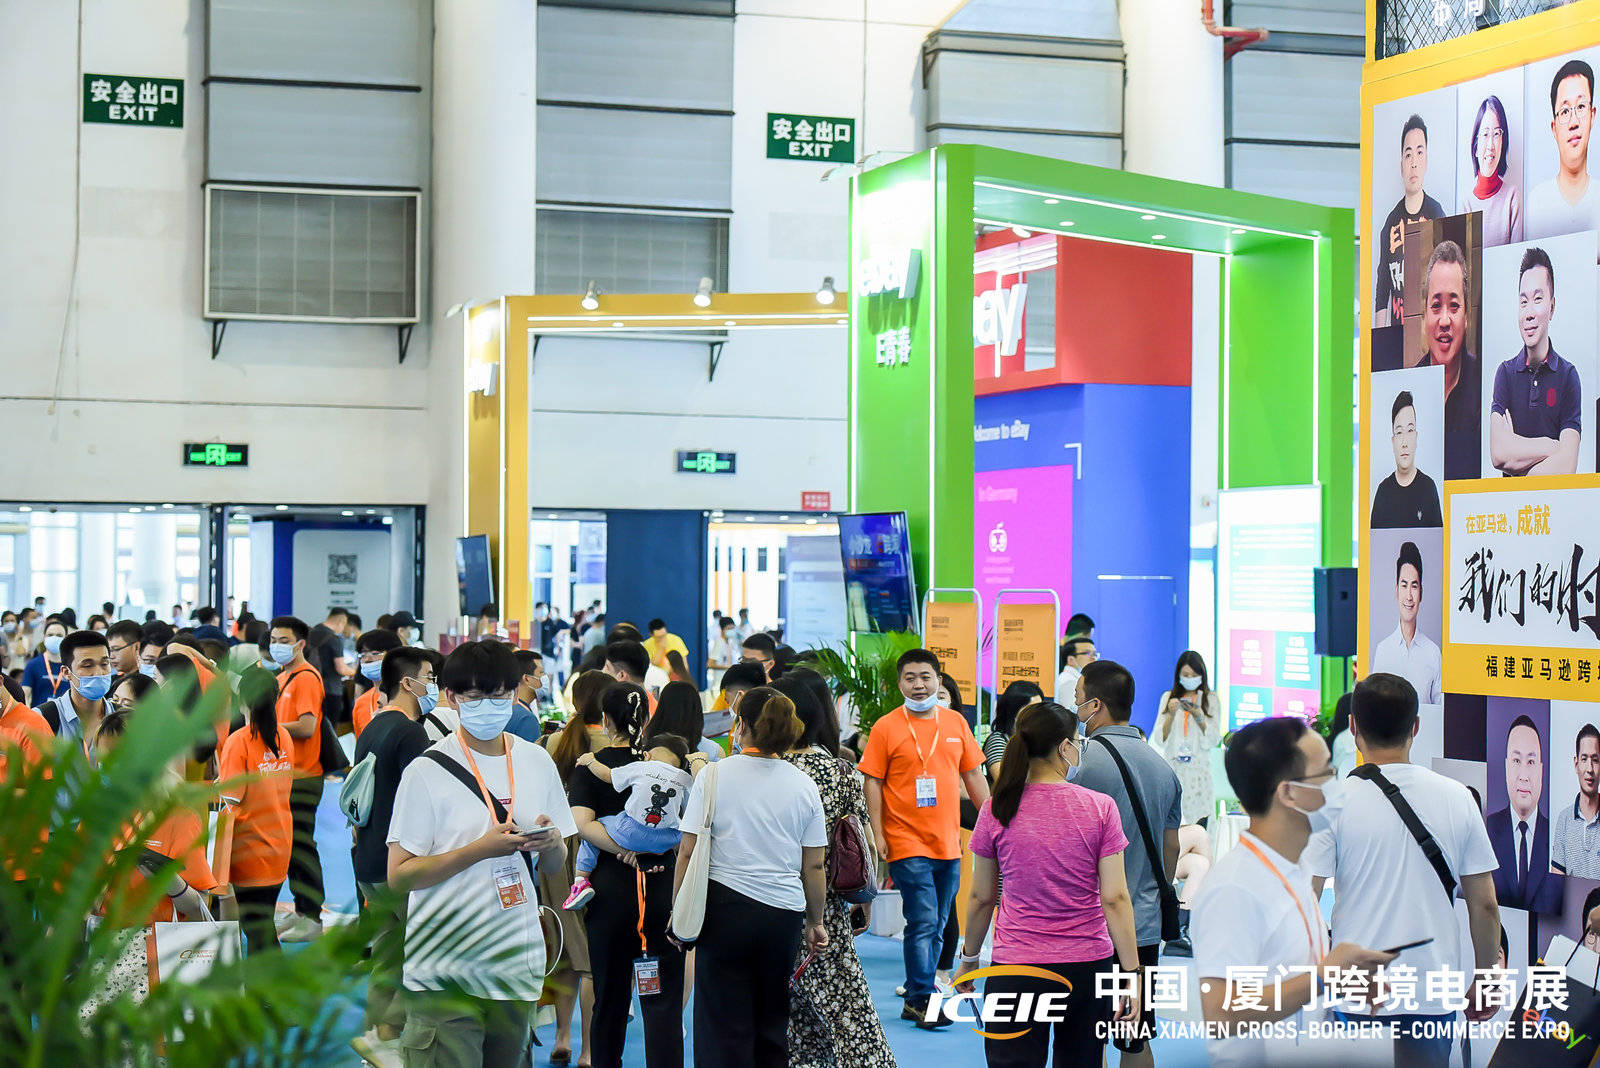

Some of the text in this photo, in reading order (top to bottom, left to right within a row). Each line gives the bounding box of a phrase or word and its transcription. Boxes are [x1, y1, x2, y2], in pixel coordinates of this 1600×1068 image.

[90, 79, 178, 105] 安全出口
[108, 104, 159, 121] EXIT
[772, 118, 851, 143] 安全出口
[788, 141, 833, 157] EXIT
[973, 284, 1028, 357] ay
[1000, 423, 1010, 439] to
[1486, 655, 1600, 683] 福建亚马逊跨
